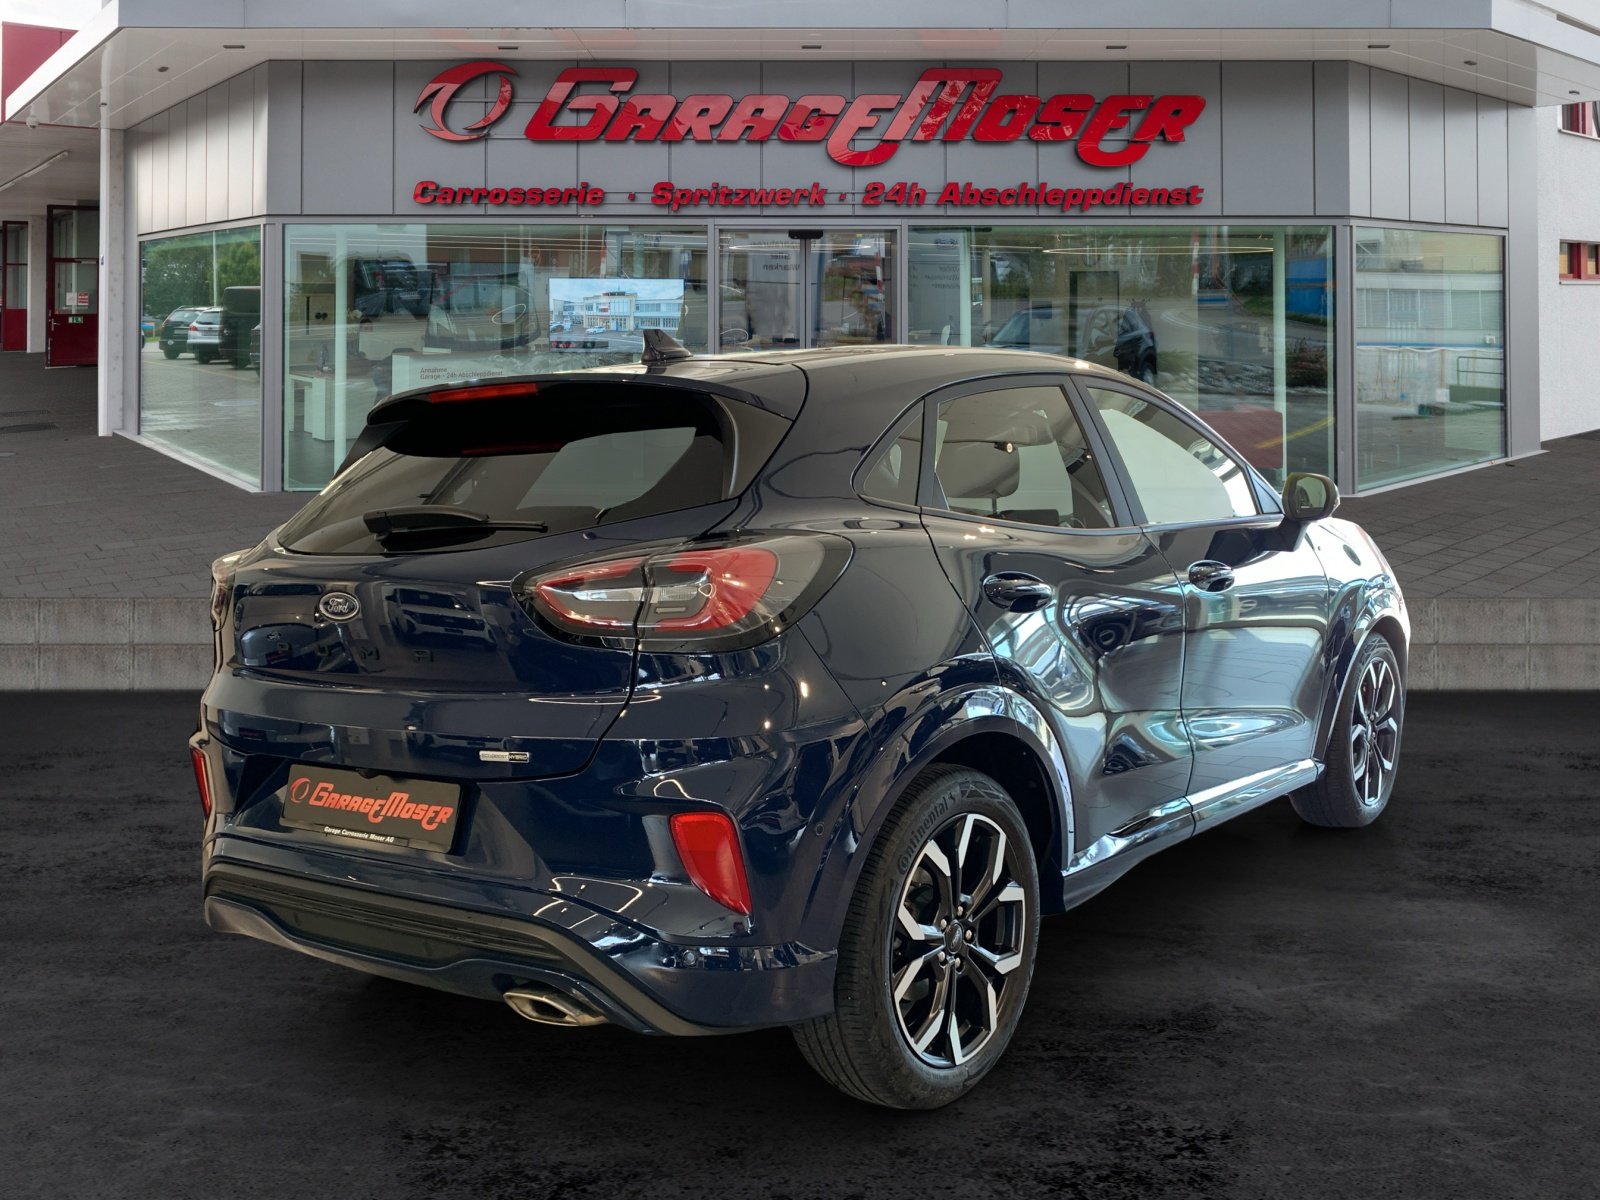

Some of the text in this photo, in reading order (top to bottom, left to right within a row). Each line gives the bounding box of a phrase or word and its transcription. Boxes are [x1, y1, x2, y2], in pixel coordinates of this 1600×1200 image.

[413, 181, 1204, 212] Carrosserie Spritzwerk 24h Abschleppdienst
[327, 597, 350, 613] Ford
[324, 826, 341, 834] Garage
[370, 833, 385, 842] Moser
